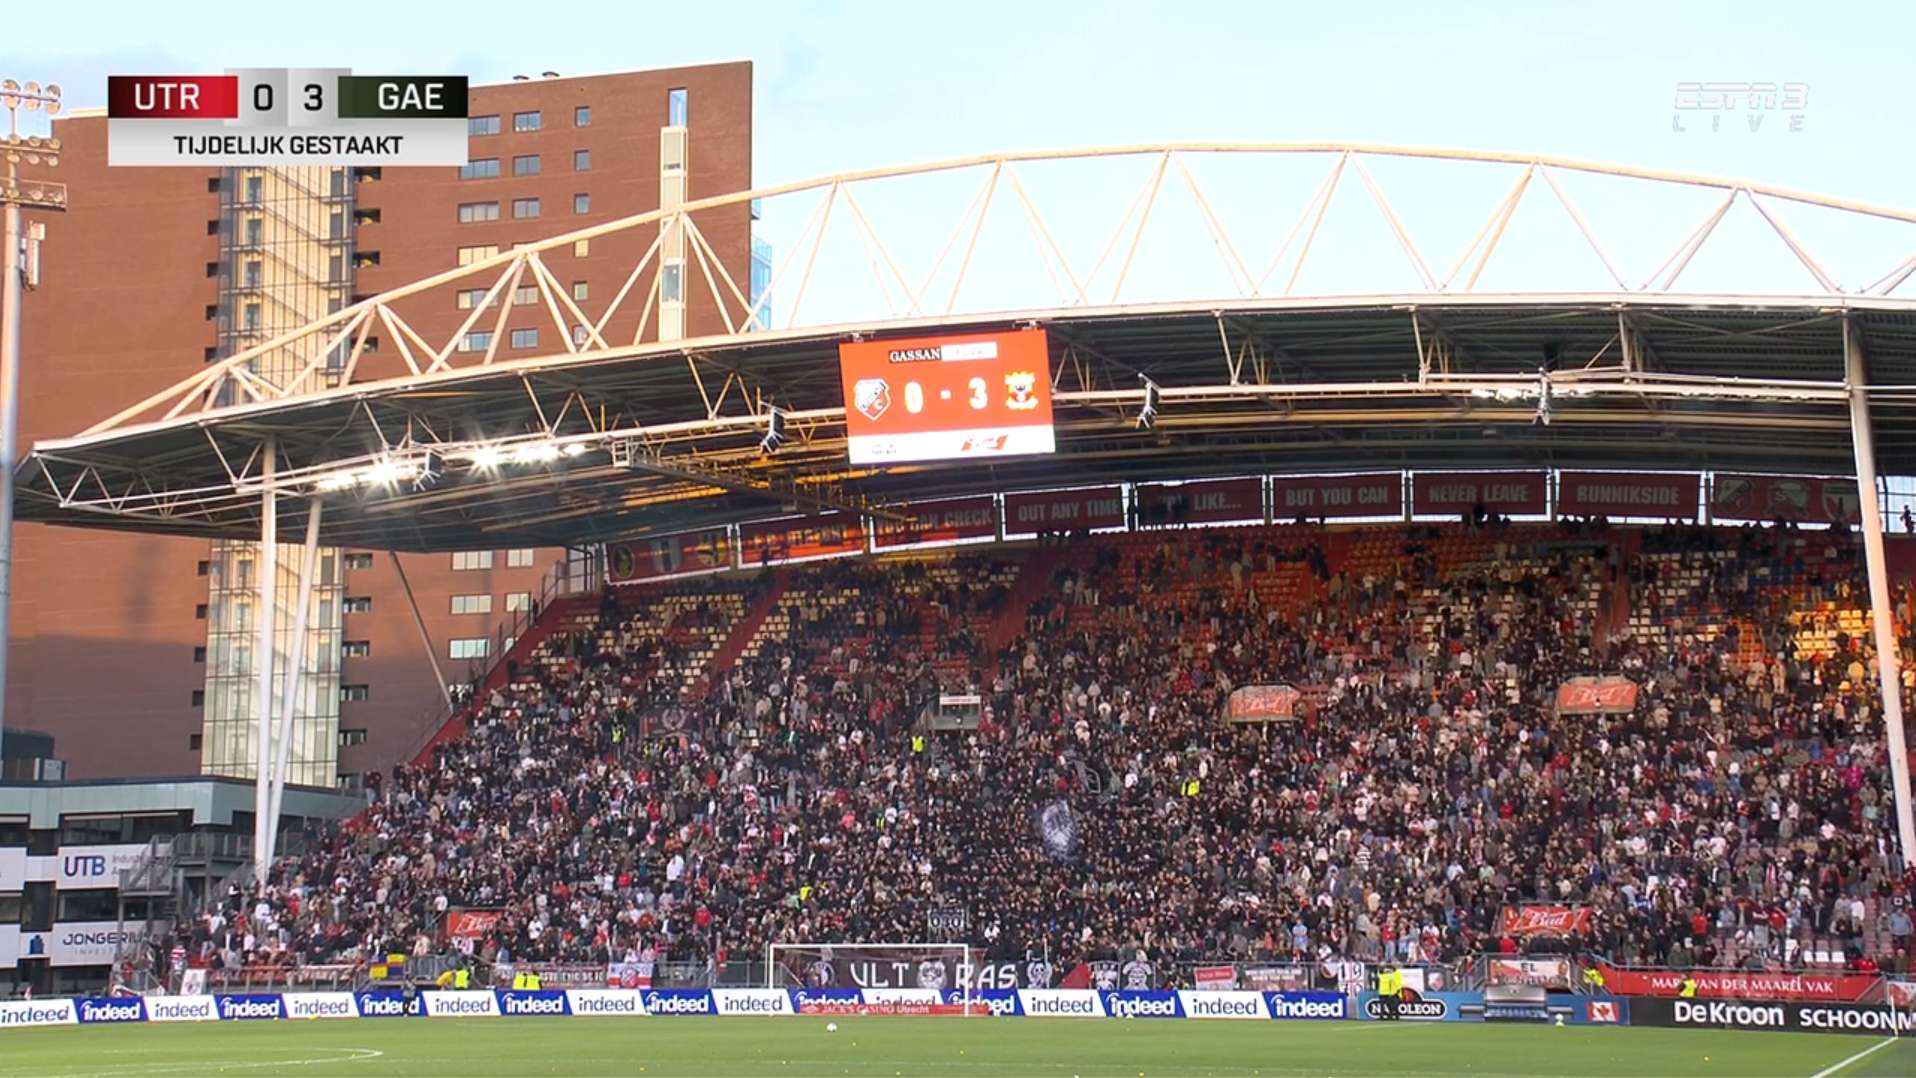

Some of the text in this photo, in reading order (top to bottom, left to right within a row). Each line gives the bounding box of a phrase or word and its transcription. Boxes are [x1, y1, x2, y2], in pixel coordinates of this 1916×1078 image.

[888, 347, 942, 363] GASSAN
[904, 381, 924, 414] 0
[968, 376, 988, 410] 3
[1285, 485, 1389, 507] BUT YOU CAN
[1428, 483, 1529, 503] NEVER LEAVE
[1576, 484, 1680, 505] BUNNIKSIDE
[944, 506, 992, 528] CHECK
[1018, 498, 1120, 522] OUT ANY TIME
[64, 855, 105, 876] UTB
[1722, 979, 1747, 991] DER
[1806, 982, 1833, 992] VAK
[81, 1001, 141, 1020] indeed
[155, 1002, 210, 1018] indeed
[221, 996, 280, 1016] indeed
[294, 999, 349, 1015] indeed
[361, 994, 420, 1014] inded
[435, 998, 490, 1013] indeed
[503, 993, 563, 1013] indeed
[578, 997, 635, 1012] indeed
[648, 992, 708, 1013] indeed
[724, 996, 783, 1012] indeed
[897, 1004, 929, 1014] Utrecht
[1031, 996, 1094, 1013] indeed
[1107, 992, 1175, 1015] indeed
[1193, 997, 1258, 1015] indeed
[1272, 995, 1343, 1017] indeed
[1371, 1003, 1440, 1015] NOLEON
[1, 1006, 70, 1024] indeed
